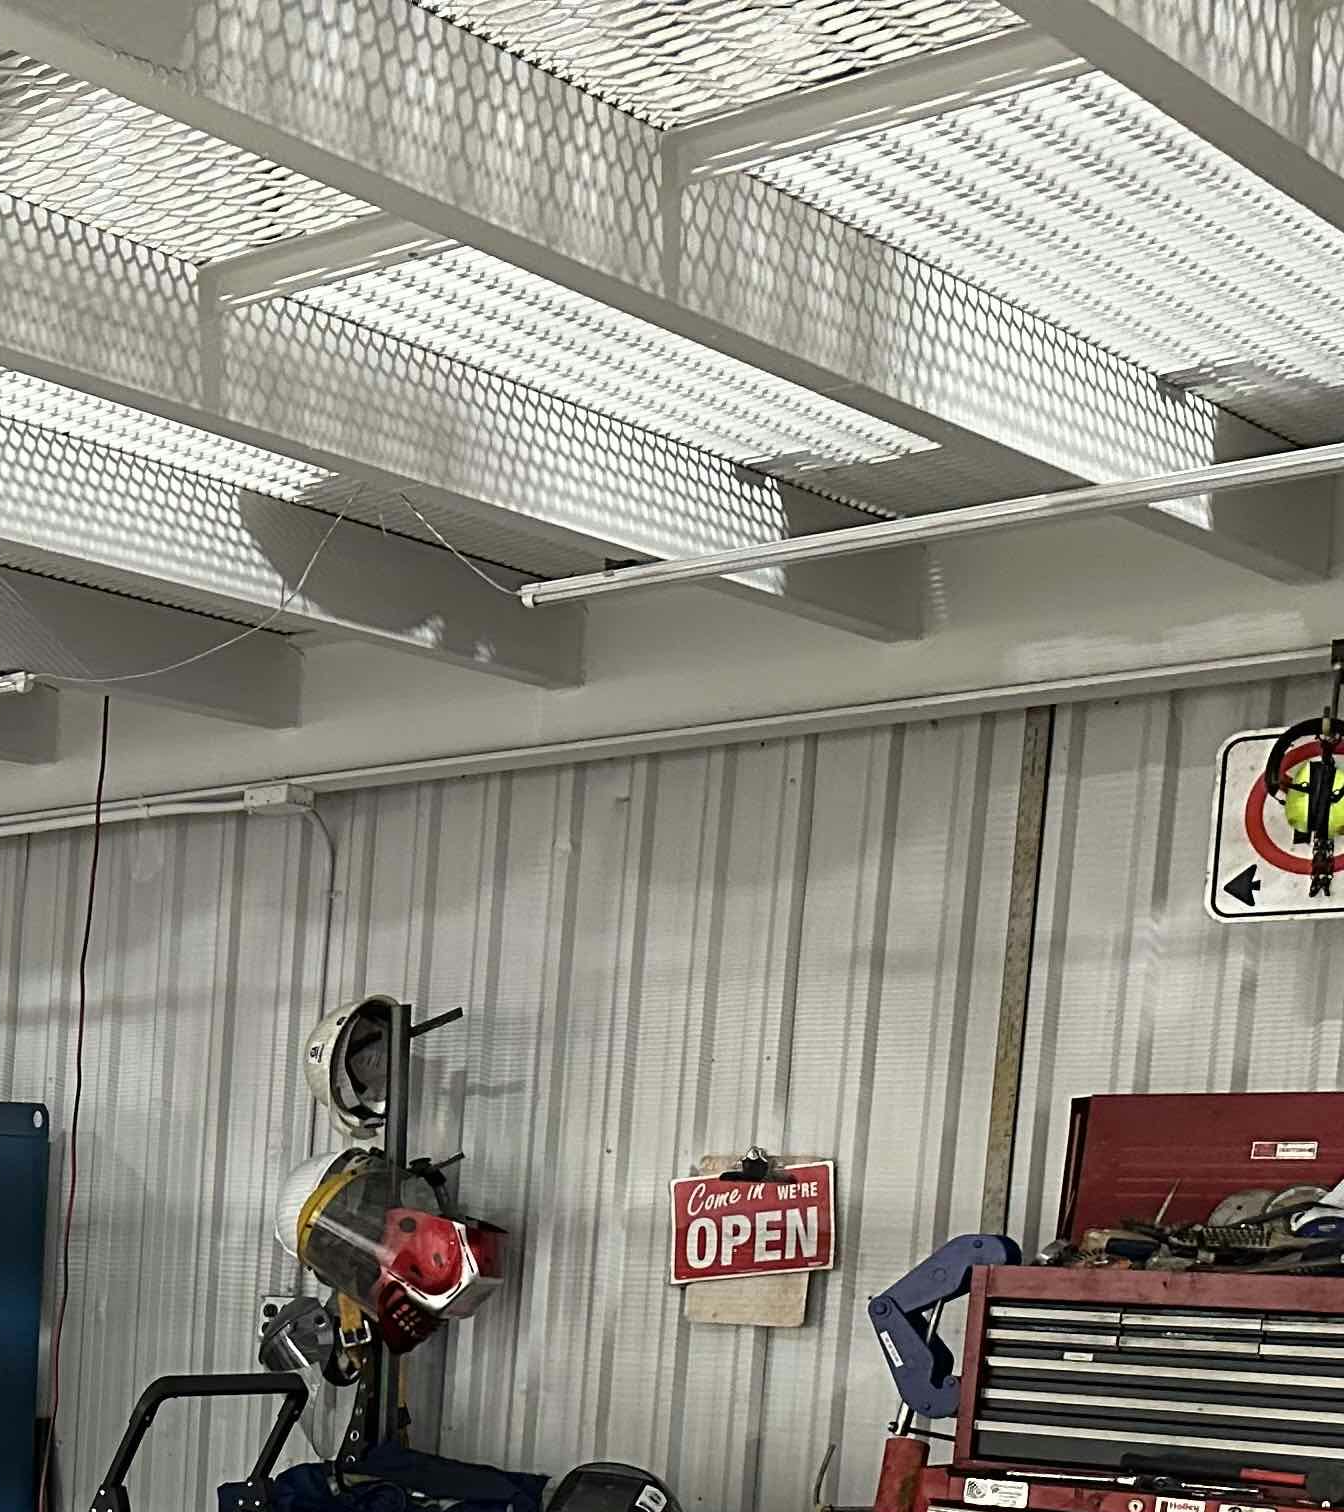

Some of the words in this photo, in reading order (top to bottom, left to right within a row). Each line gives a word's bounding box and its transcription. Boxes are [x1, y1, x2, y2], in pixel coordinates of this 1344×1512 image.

[687, 1183, 741, 1216] Come
[777, 1181, 818, 1200] WE'RE
[686, 1206, 818, 1270] OPEN
